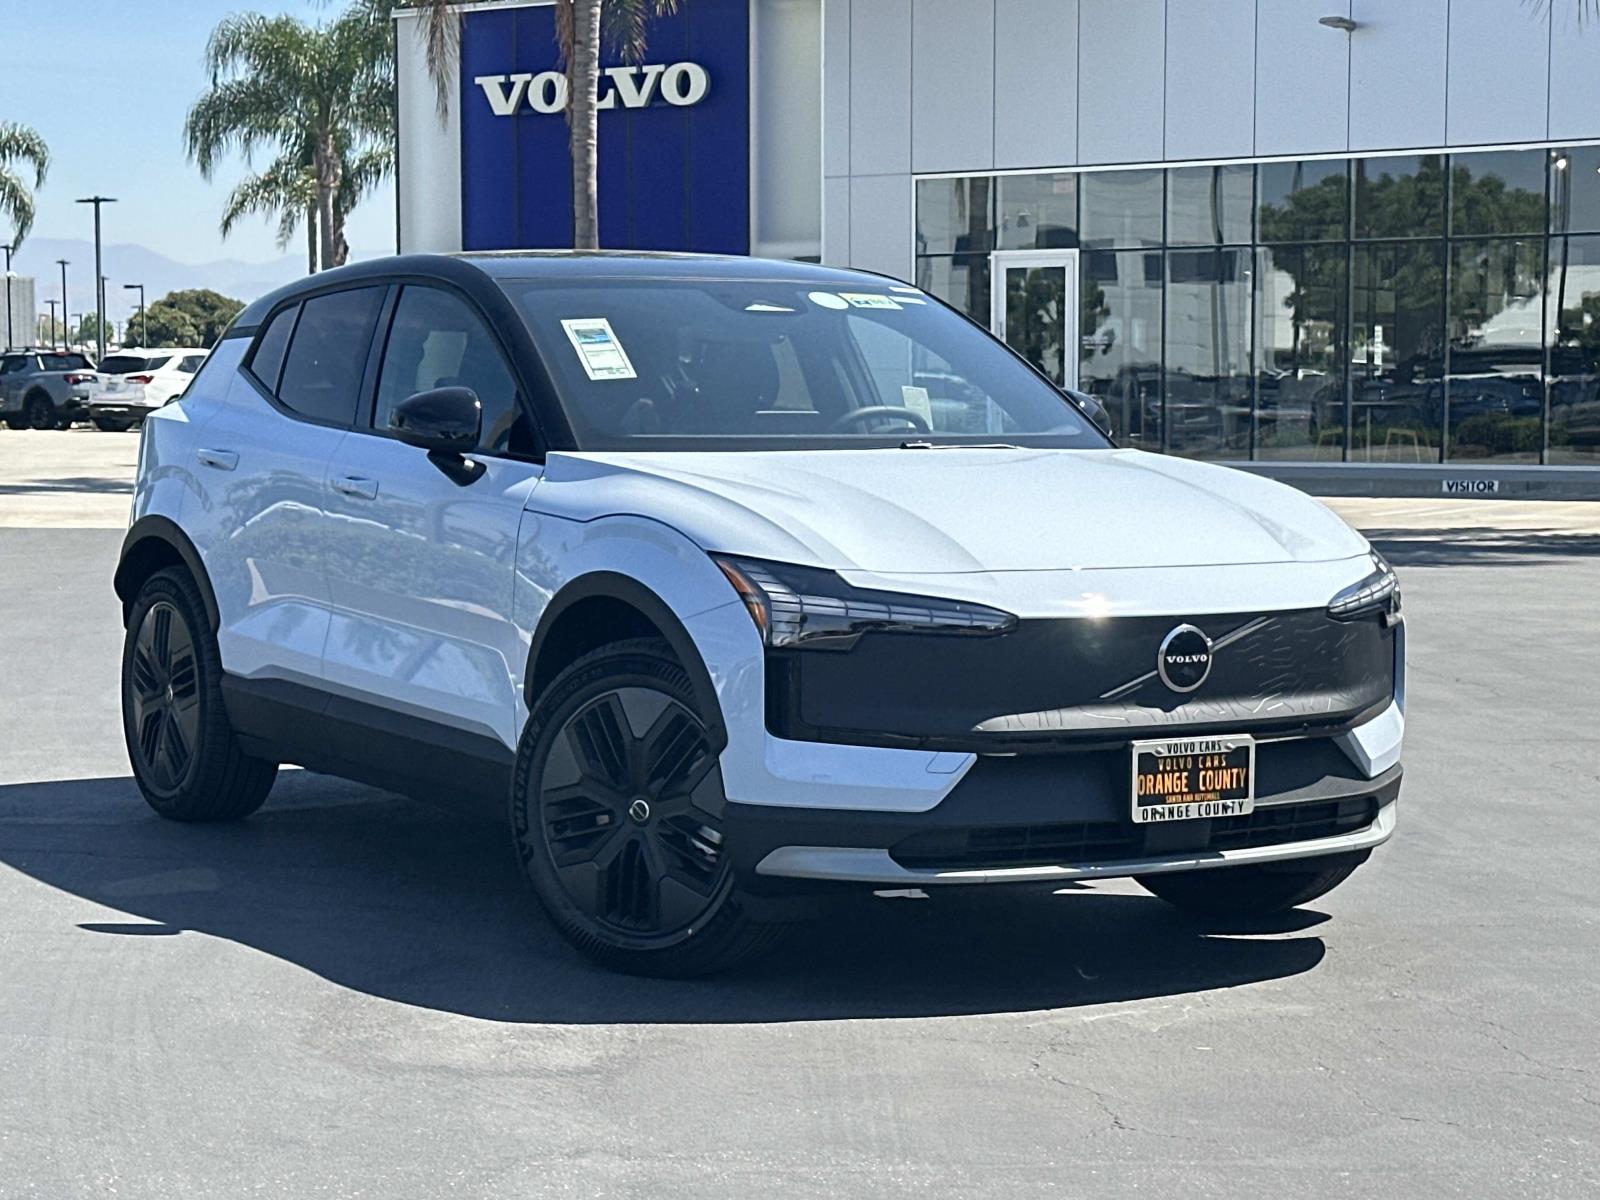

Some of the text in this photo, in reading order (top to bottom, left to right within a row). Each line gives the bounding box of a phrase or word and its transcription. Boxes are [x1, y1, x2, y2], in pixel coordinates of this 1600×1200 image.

[1446, 480, 1495, 492] VISITOR
[1166, 654, 1208, 664] VOLVO
[1167, 741, 1222, 754] VOLVO CARS
[1158, 754, 1226, 771] VOLVO CARS
[1138, 768, 1246, 795] ORANGE COUNTY
